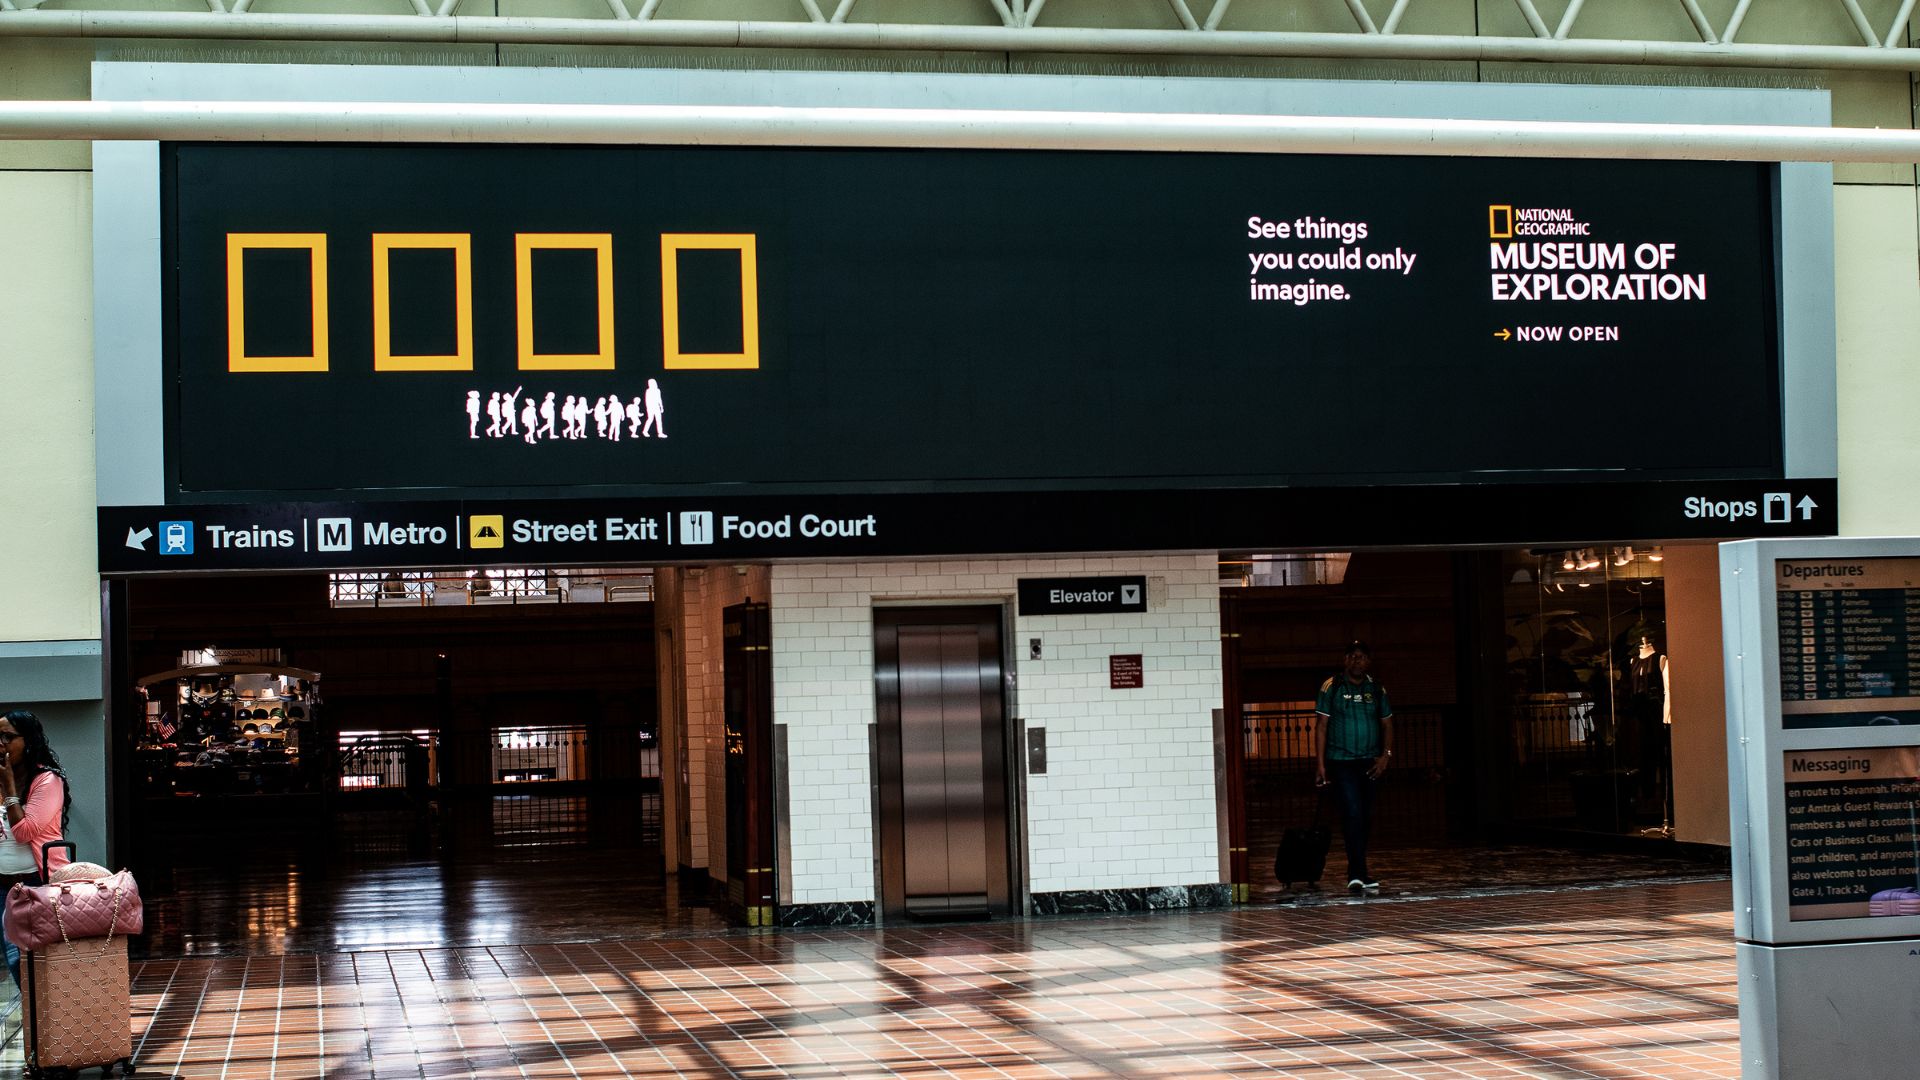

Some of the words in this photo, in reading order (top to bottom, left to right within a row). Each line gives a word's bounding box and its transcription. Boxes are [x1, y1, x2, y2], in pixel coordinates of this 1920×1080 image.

[1515, 208, 1574, 222] NATIONAL
[1248, 216, 1290, 238] See
[1294, 216, 1368, 244] things
[1515, 222, 1590, 236] GEOGRAPHIC
[1248, 253, 1292, 274] you
[1298, 247, 1361, 270] could
[1366, 247, 1416, 274] only
[1490, 243, 1626, 270] MUSEUM
[1634, 243, 1676, 269] OF
[1250, 278, 1350, 305] imagine.
[1492, 274, 1706, 300] EXPLORATION
[1517, 326, 1563, 341] NOW
[1568, 326, 1619, 341] OPEN
[1684, 496, 1758, 522] Shops
[206, 525, 294, 548] Trains
[322, 523, 347, 546] M
[363, 522, 447, 546] Metro
[512, 519, 598, 543] Street
[606, 518, 658, 541] Exit
[722, 515, 791, 539] Food
[800, 514, 876, 538] Court
[1783, 564, 1864, 580] Departures
[1050, 589, 1114, 603] Elevator
[1792, 756, 1871, 773] Messaging
[1789, 789, 1800, 798] en
[1803, 787, 1828, 797] route
[1830, 787, 1840, 796] to
[1789, 805, 1805, 814] our
[1807, 803, 1841, 813] Amtrak
[1844, 802, 1871, 811] Guest
[1874, 801, 1913, 810] Rewards
[1790, 820, 1833, 830] members
[1848, 818, 1867, 828] well
[1869, 819, 1879, 827] as
[1791, 838, 1811, 847] Cars
[1813, 838, 1822, 846] or
[1825, 835, 1864, 845] Business
[1791, 854, 1815, 863] small
[1818, 853, 1858, 862] children,
[1861, 851, 1878, 860] and
[1880, 851, 1913, 861] anyone
[1792, 871, 1809, 880] also
[1813, 870, 1857, 879] welcome
[1857, 869, 1867, 877] to
[1869, 867, 1896, 876] board
[1792, 888, 1815, 897] Gate
[1826, 886, 1851, 895] Track
[1853, 885, 1867, 894] 24.
